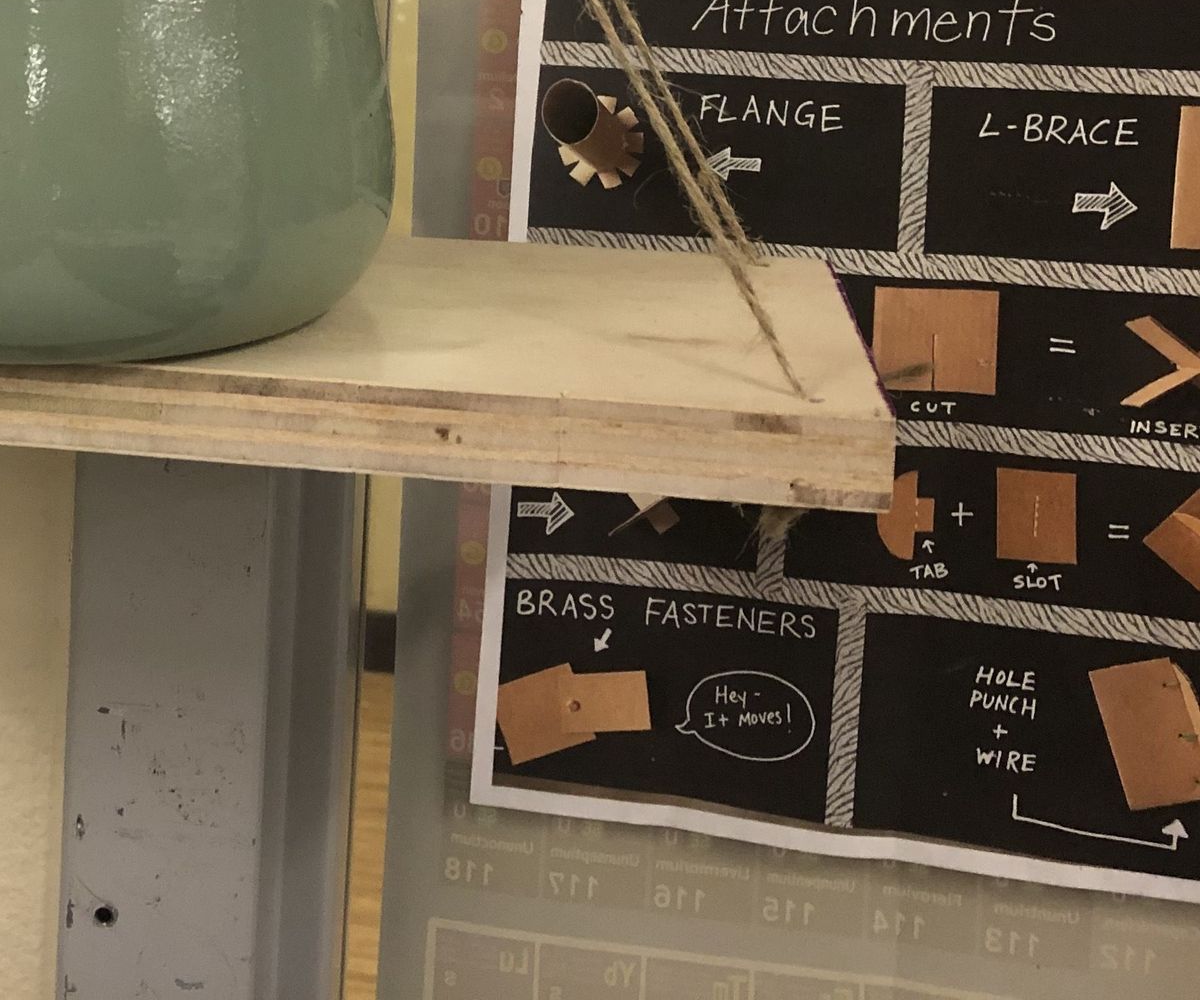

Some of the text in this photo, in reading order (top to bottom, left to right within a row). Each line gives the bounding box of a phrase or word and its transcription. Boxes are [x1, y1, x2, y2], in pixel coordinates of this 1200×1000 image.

[700, 93, 844, 133] FLANGE
[978, 112, 1139, 146] L-BRACE
[910, 400, 957, 415] CUT
[909, 562, 949, 580] TAB
[1012, 574, 1063, 591] SLOT
[516, 589, 816, 639] BRASS FASTENERS
[974, 665, 1036, 692] HOLE
[715, 685, 747, 709] Hey
[969, 689, 1037, 720] PUNCH
[704, 712, 729, 729] It
[976, 747, 1037, 773] WIRE
